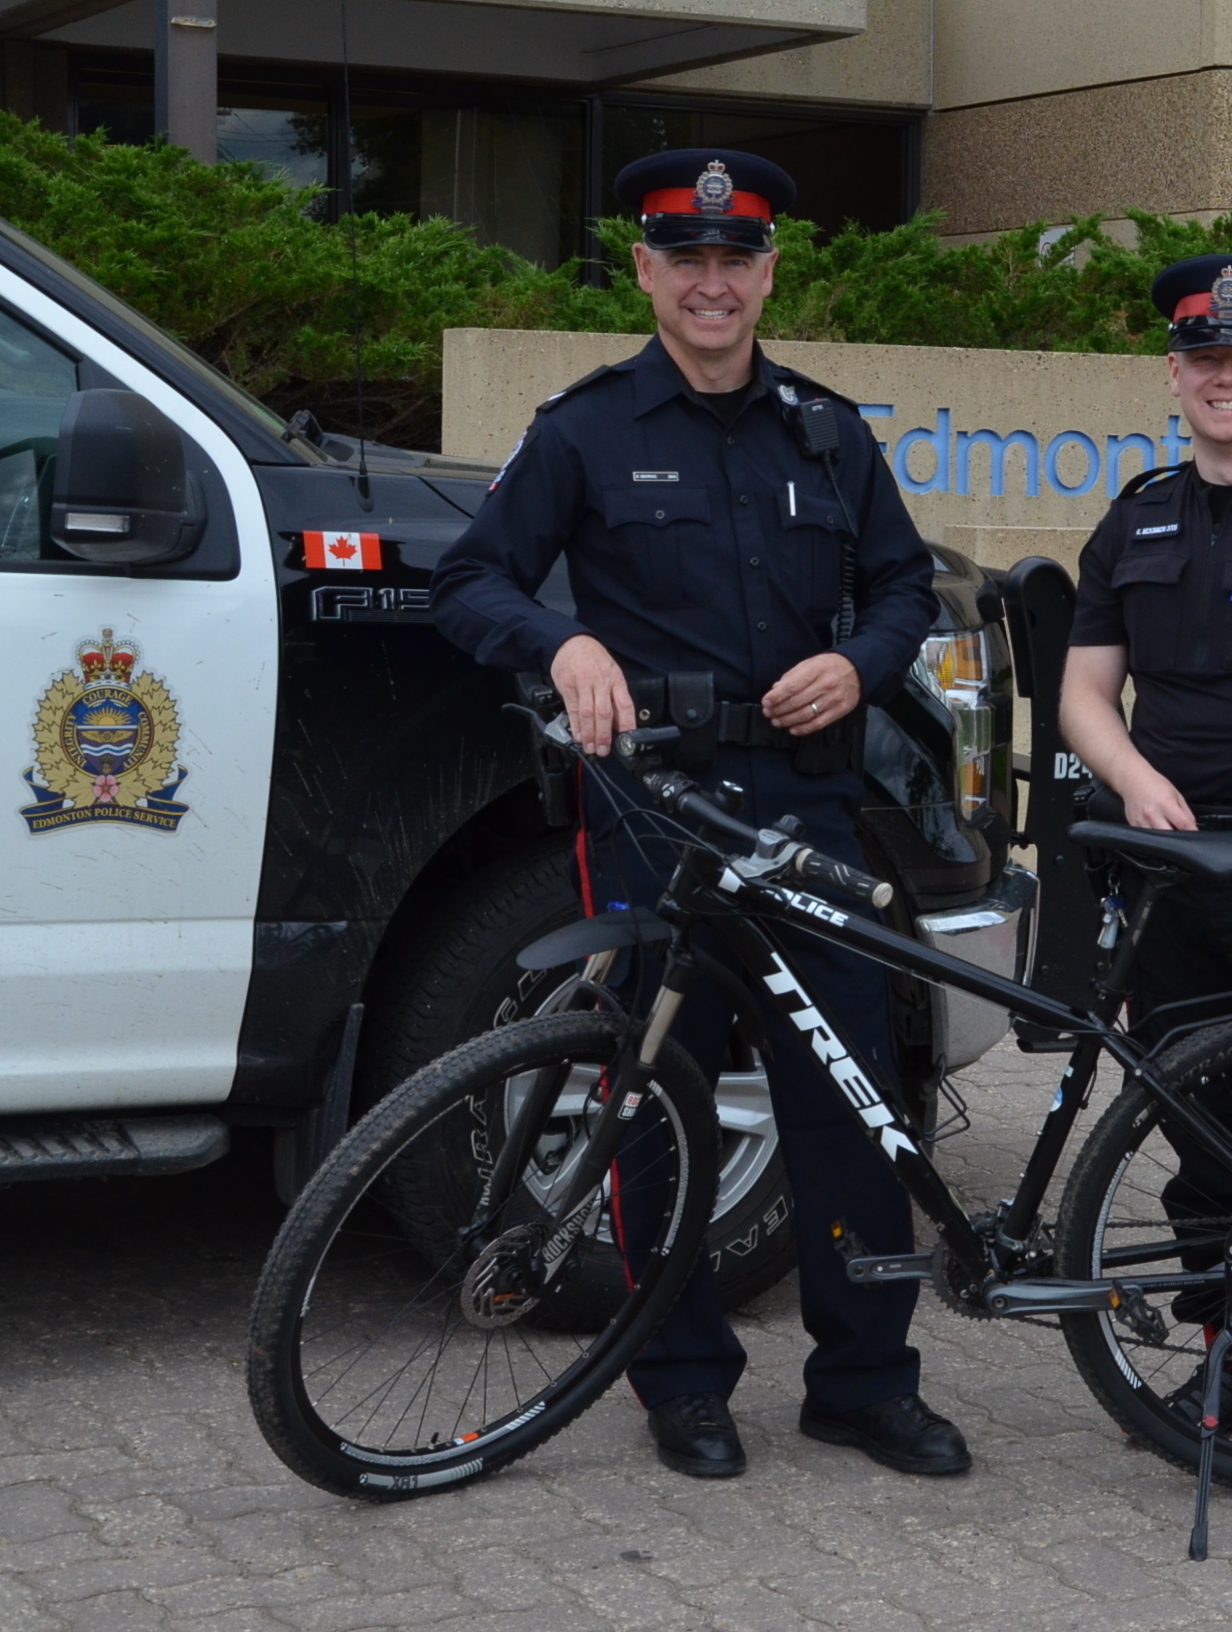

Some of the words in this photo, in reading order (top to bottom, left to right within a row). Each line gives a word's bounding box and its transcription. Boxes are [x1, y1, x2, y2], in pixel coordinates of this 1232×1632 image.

[82, 689, 133, 705] COURAGE
[64, 712, 88, 769] INTEGRITY
[122, 711, 150, 771] COMMUNITY
[33, 808, 92, 829] EDMONTON
[94, 807, 132, 819] POLICE
[133, 810, 176, 829] SERVICE
[762, 951, 919, 1173] TREK
